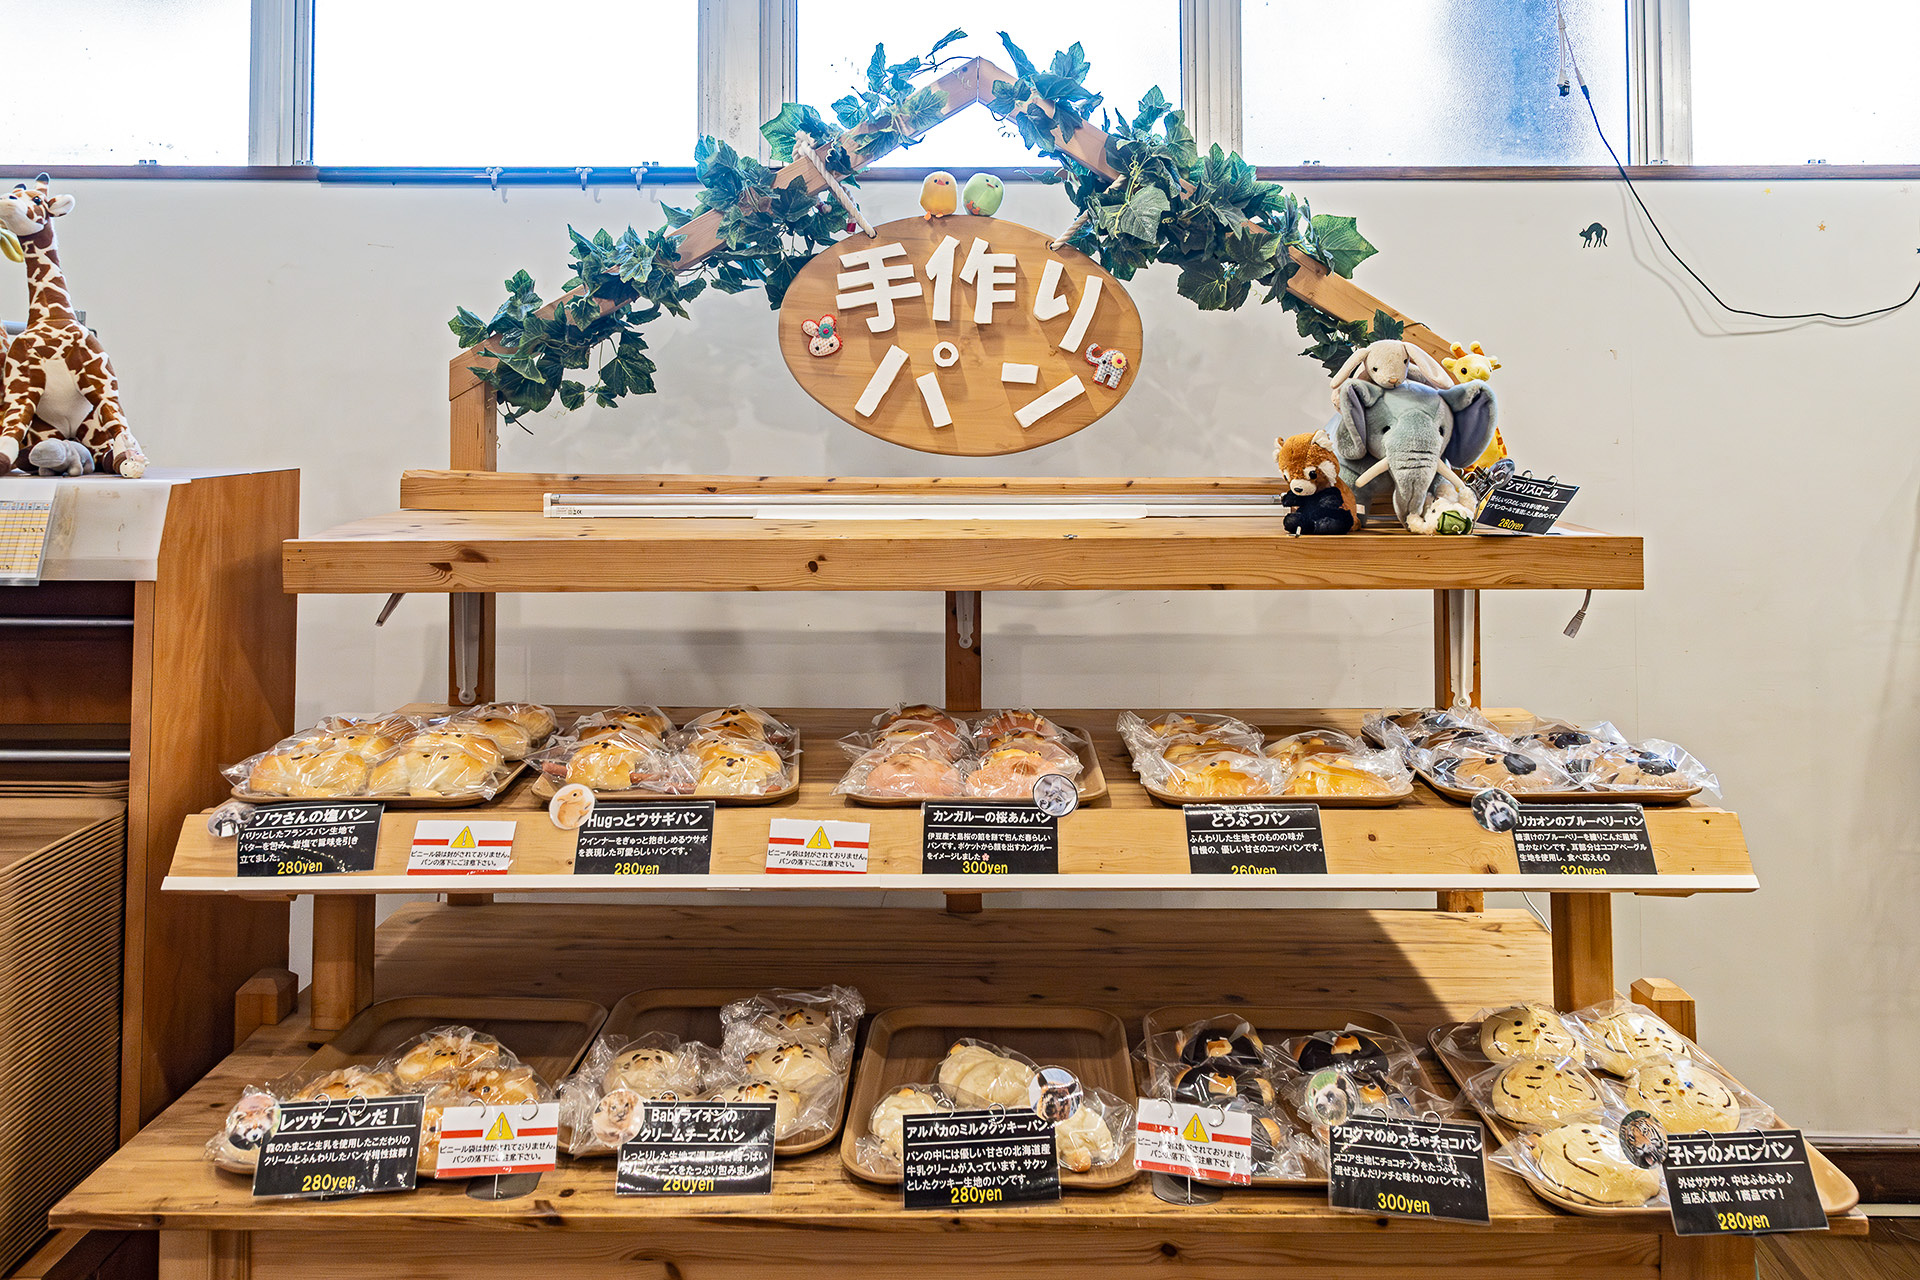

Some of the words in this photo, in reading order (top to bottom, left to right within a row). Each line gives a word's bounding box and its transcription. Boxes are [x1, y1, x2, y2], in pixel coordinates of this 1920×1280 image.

[835, 235, 1103, 353] 手作り
[854, 340, 1086, 428] パン
[1505, 480, 1559, 499] シマリスロール
[1497, 518, 1525, 531] 280yen
[587, 812, 703, 829] Hugっとウサギパン
[933, 810, 1051, 824] カンガルーの桜あんパン
[1211, 812, 1290, 828] どうぶつパン
[1518, 814, 1644, 827] リカオンのブルーベリーパン
[277, 860, 323, 875] 280yen
[614, 862, 660, 875] 280yen
[962, 861, 1008, 875] 300yen
[640, 1128, 746, 1143] クリームチーズパン
[906, 1143, 1051, 1161] パンの中には優しい甘さの北海道産
[1668, 1142, 1794, 1165] 子トラのメロンパン
[906, 1159, 1048, 1177] 牛乳クリームが入っています。サクッ
[301, 1173, 356, 1192] 280yen
[662, 1178, 715, 1193] 280yen
[906, 1174, 1031, 1191] としたクッキー生地のパンです。
[951, 1187, 1003, 1204] 280yen
[1378, 1192, 1431, 1214] 300yen
[1718, 1211, 1771, 1231] 280yen
